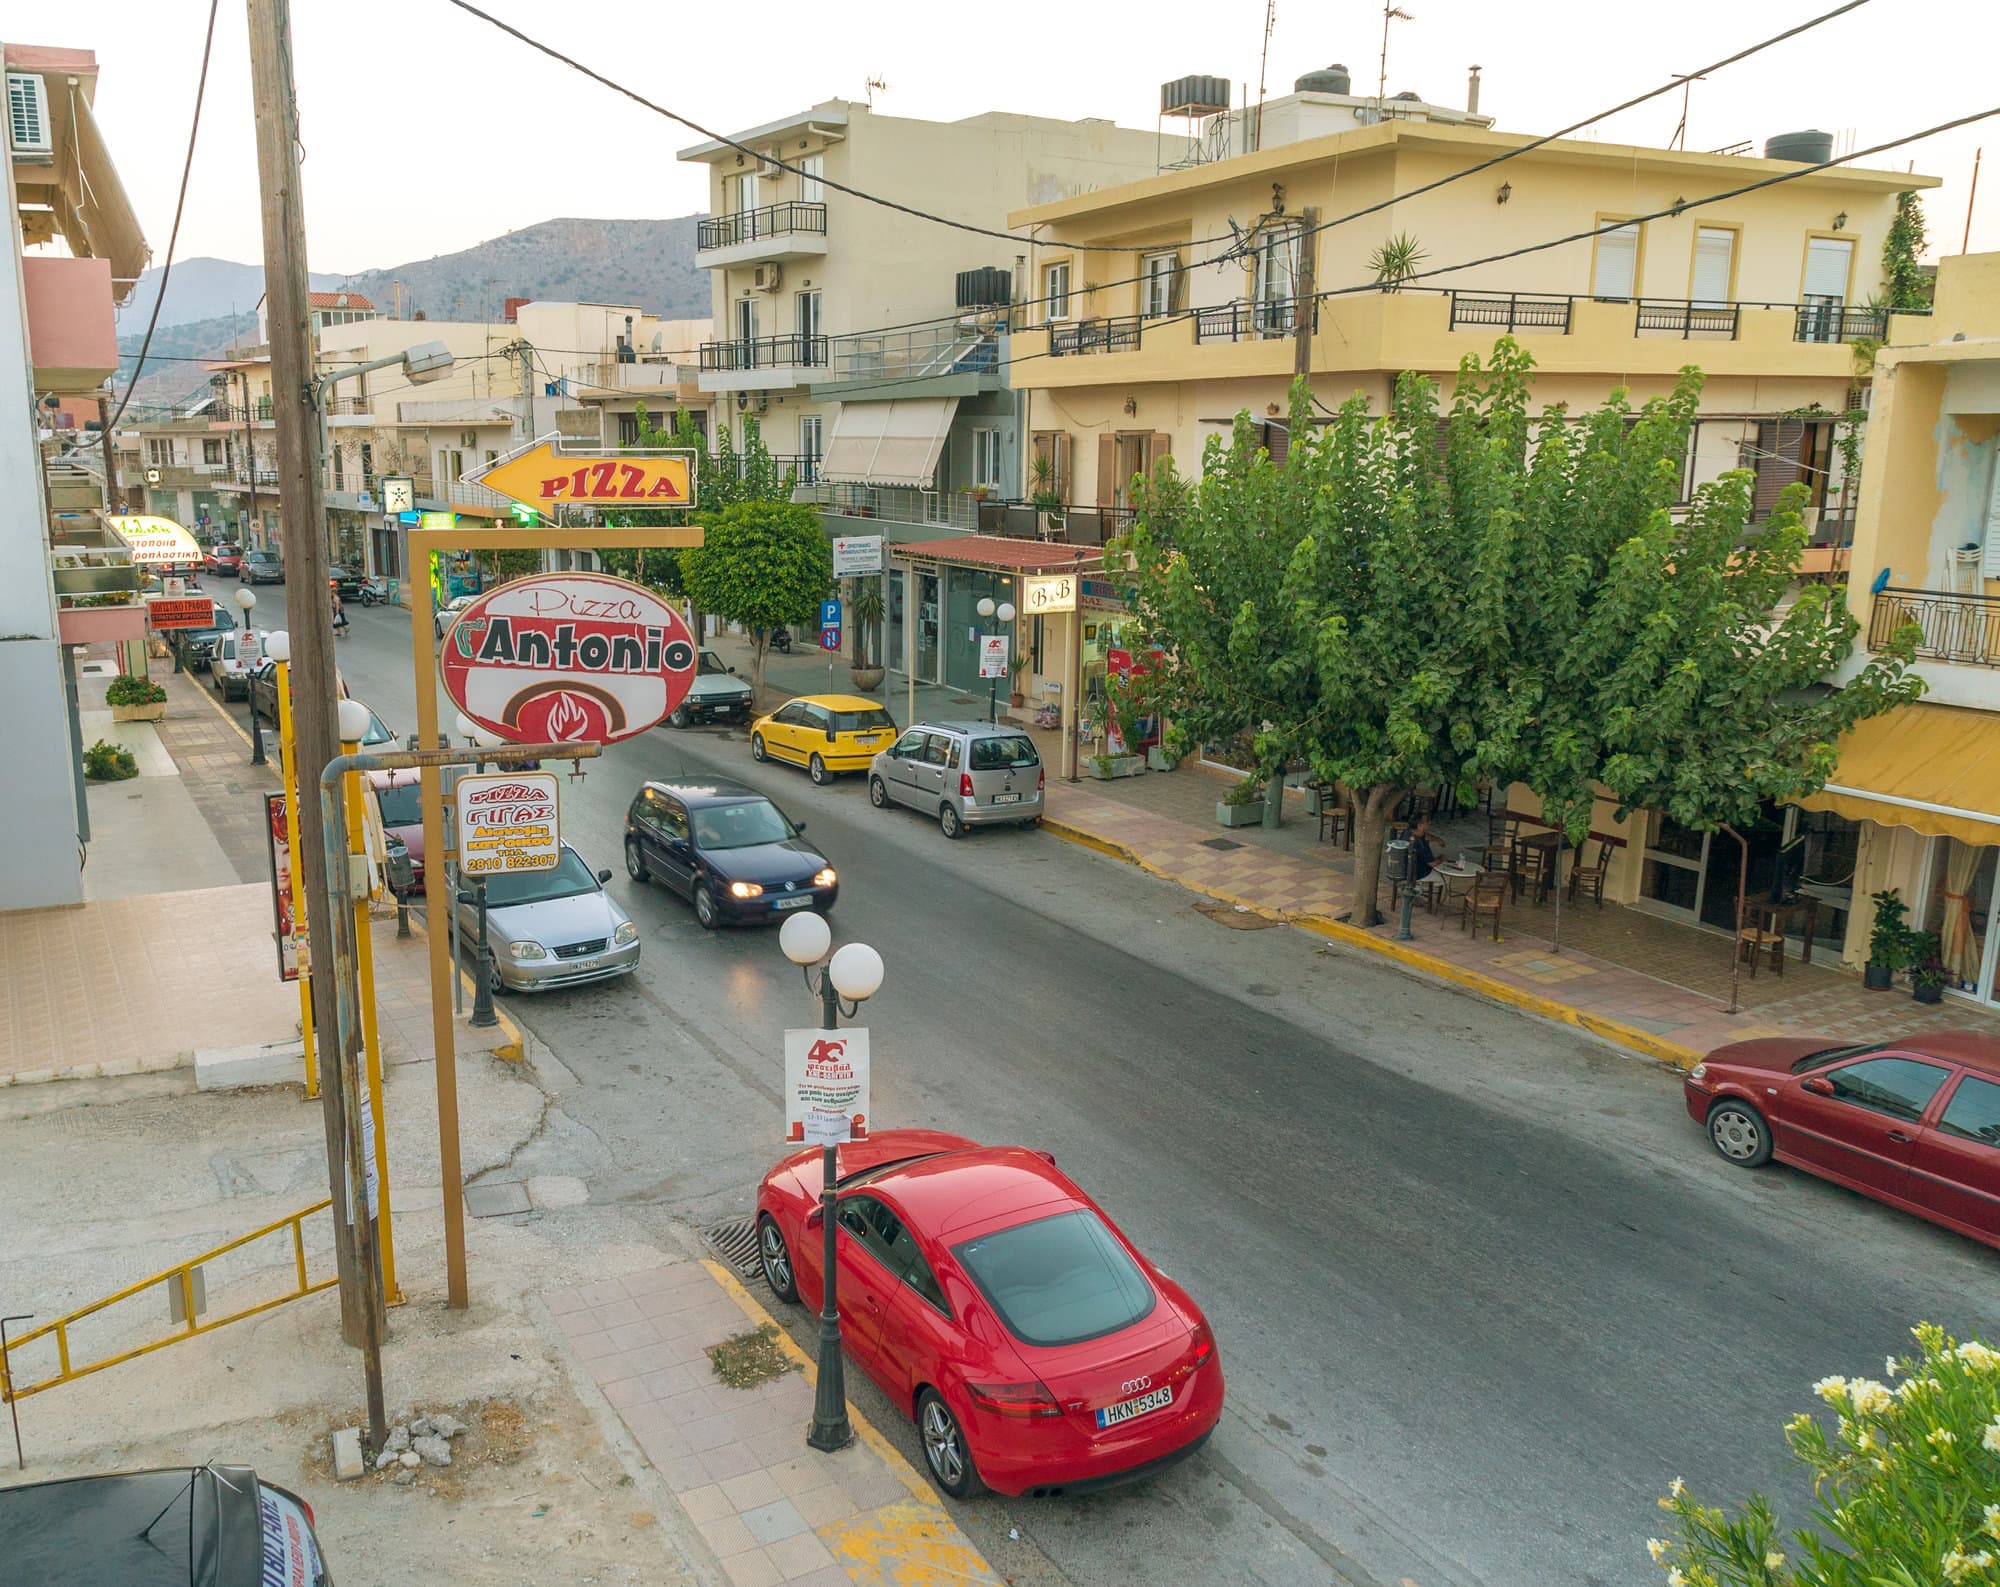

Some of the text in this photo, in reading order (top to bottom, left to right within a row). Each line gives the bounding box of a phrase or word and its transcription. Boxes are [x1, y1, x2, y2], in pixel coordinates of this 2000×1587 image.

[540, 462, 681, 498] PIZZA
[518, 587, 642, 620] Pizza
[1032, 588, 1047, 607] B
[1055, 579, 1070, 599] B
[827, 604, 836, 619] P
[477, 617, 694, 673] Antonio
[469, 784, 549, 804] PIZZA
[467, 804, 554, 825] ΓΙΓΑΣ
[468, 854, 555, 871] 2810 822307
